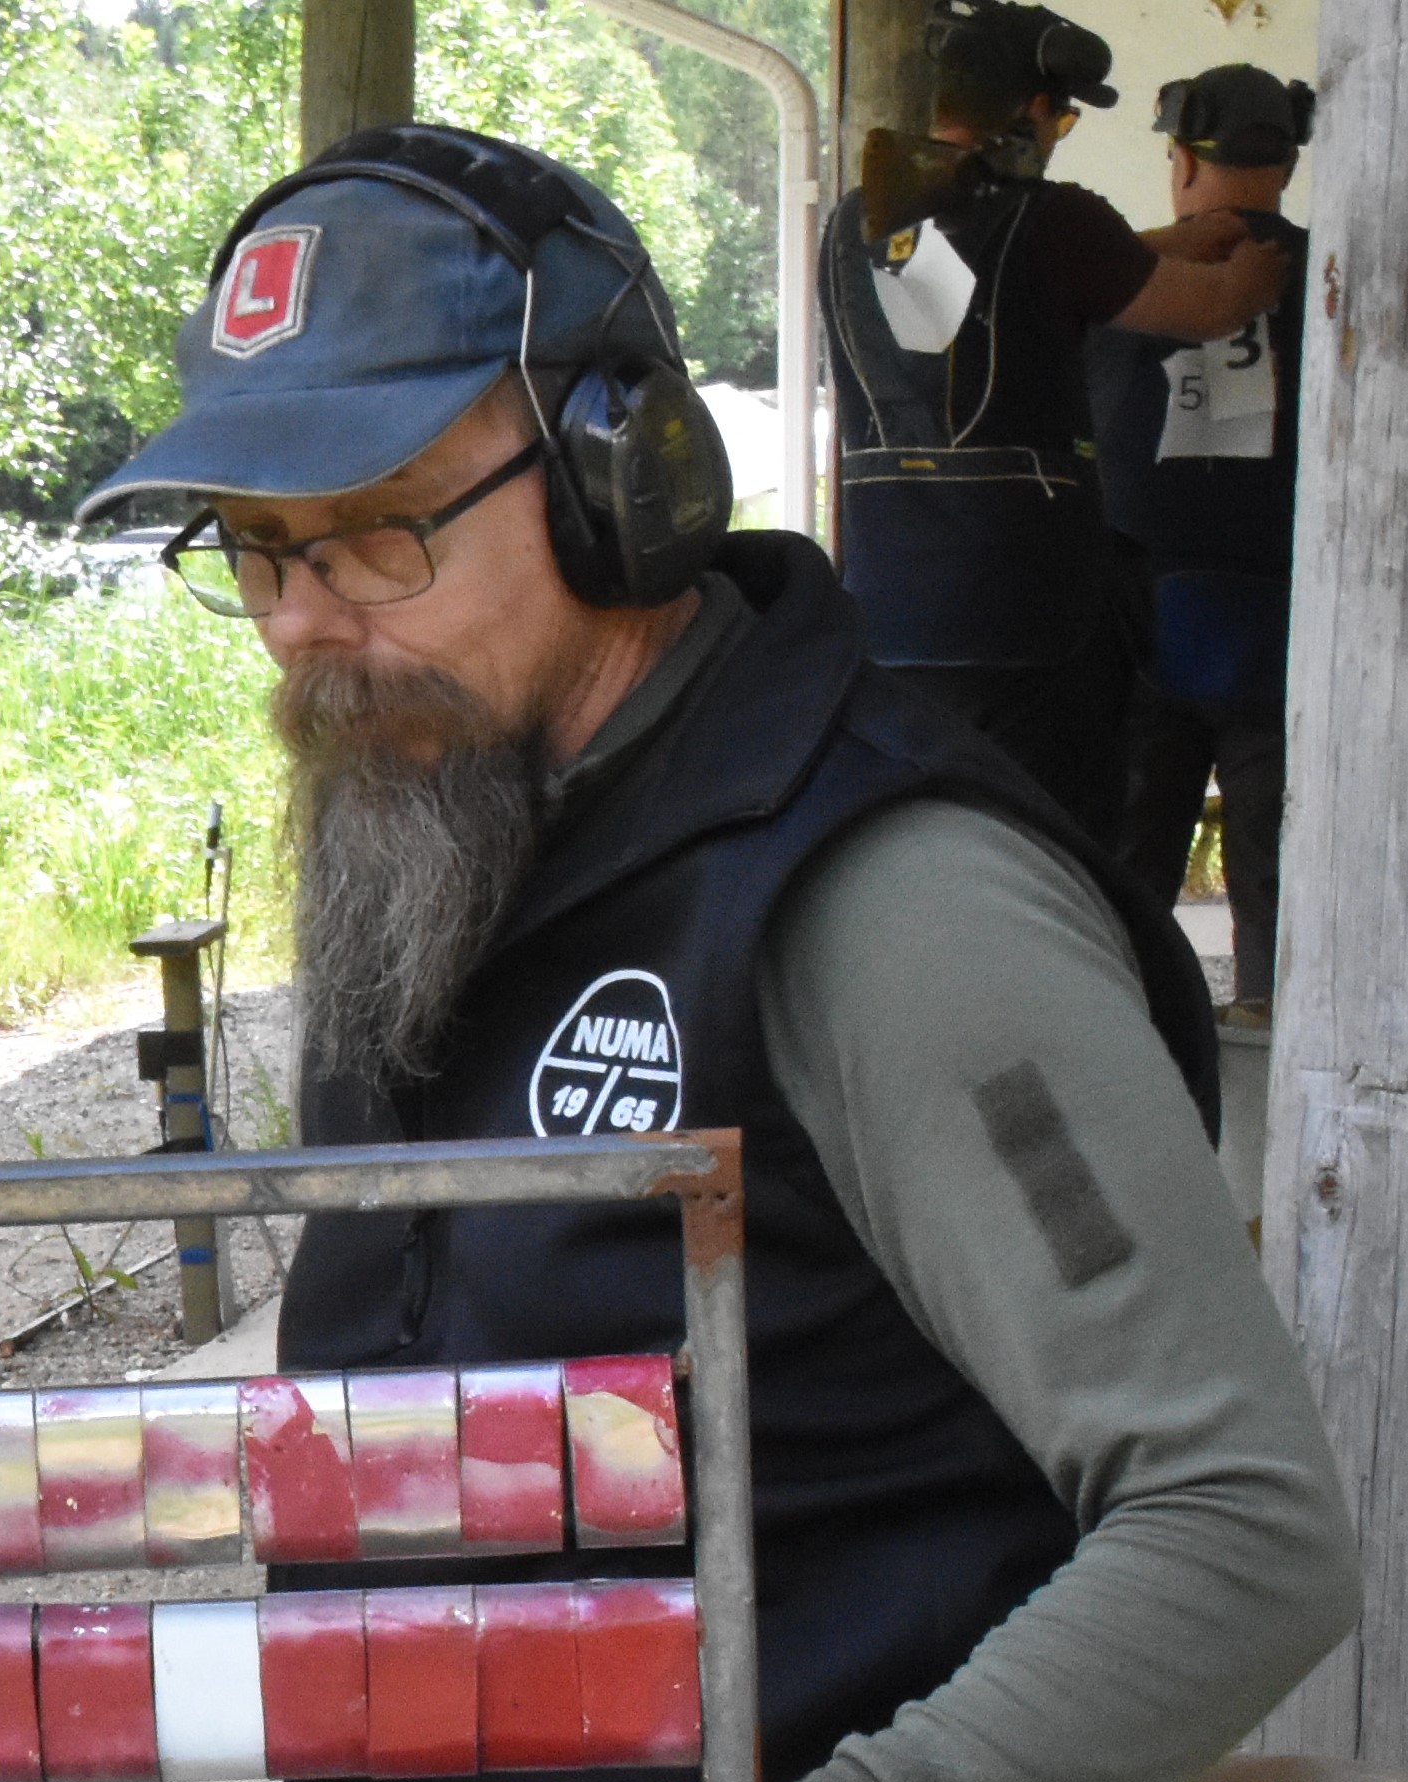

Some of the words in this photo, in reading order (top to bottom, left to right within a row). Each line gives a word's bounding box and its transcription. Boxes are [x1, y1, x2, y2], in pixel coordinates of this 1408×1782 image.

[233, 257, 275, 317] L
[1178, 375, 1203, 411] 5
[570, 1014, 670, 1063] NUMA
[551, 1084, 588, 1118] 19
[609, 1096, 658, 1133] 65
